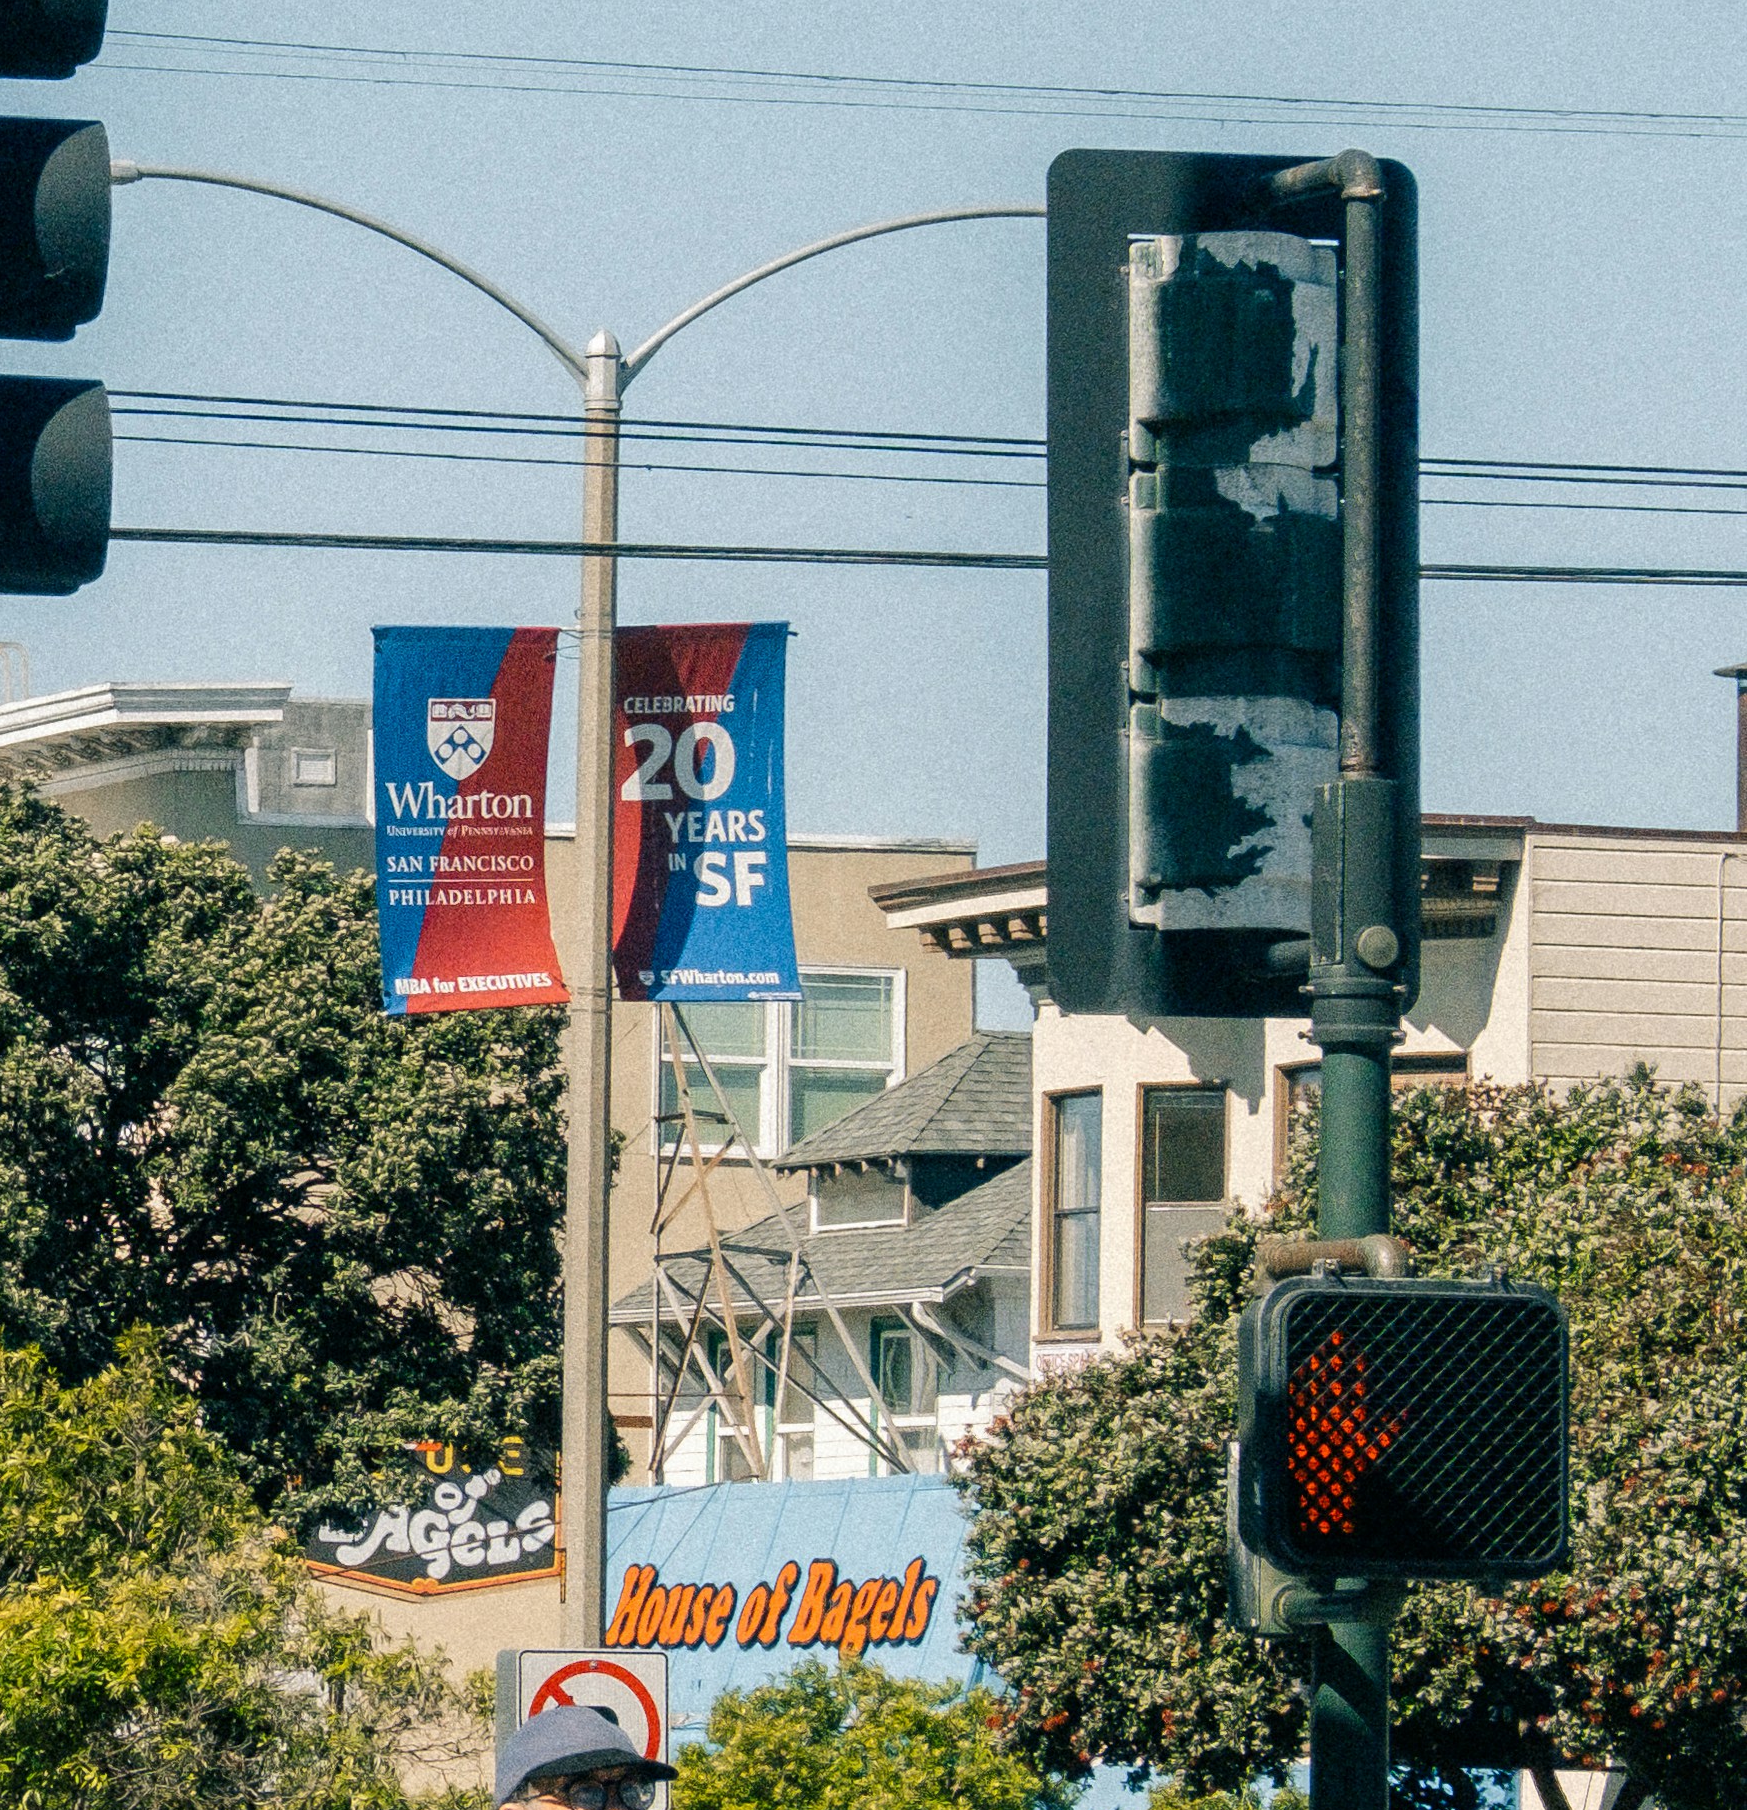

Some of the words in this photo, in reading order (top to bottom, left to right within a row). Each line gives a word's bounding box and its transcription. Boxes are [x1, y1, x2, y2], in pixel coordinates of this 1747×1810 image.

[624, 694, 735, 714] CELEBRATING
[621, 721, 736, 801] 20
[385, 781, 534, 819] Wharton
[664, 809, 766, 843] YEARS
[386, 855, 423, 873] SAN
[429, 855, 535, 873] FRANCISCO
[668, 852, 687, 872] IN
[693, 851, 768, 907] SF
[389, 888, 536, 906] PHILADELPHIA
[394, 978, 432, 995] MBA
[433, 976, 456, 993] for
[457, 972, 553, 992] EXECUTIVES
[660, 969, 781, 985] SFWharton.com
[604, 1561, 738, 1650] House
[735, 1559, 802, 1651] of
[785, 1554, 942, 1662] Bagels
